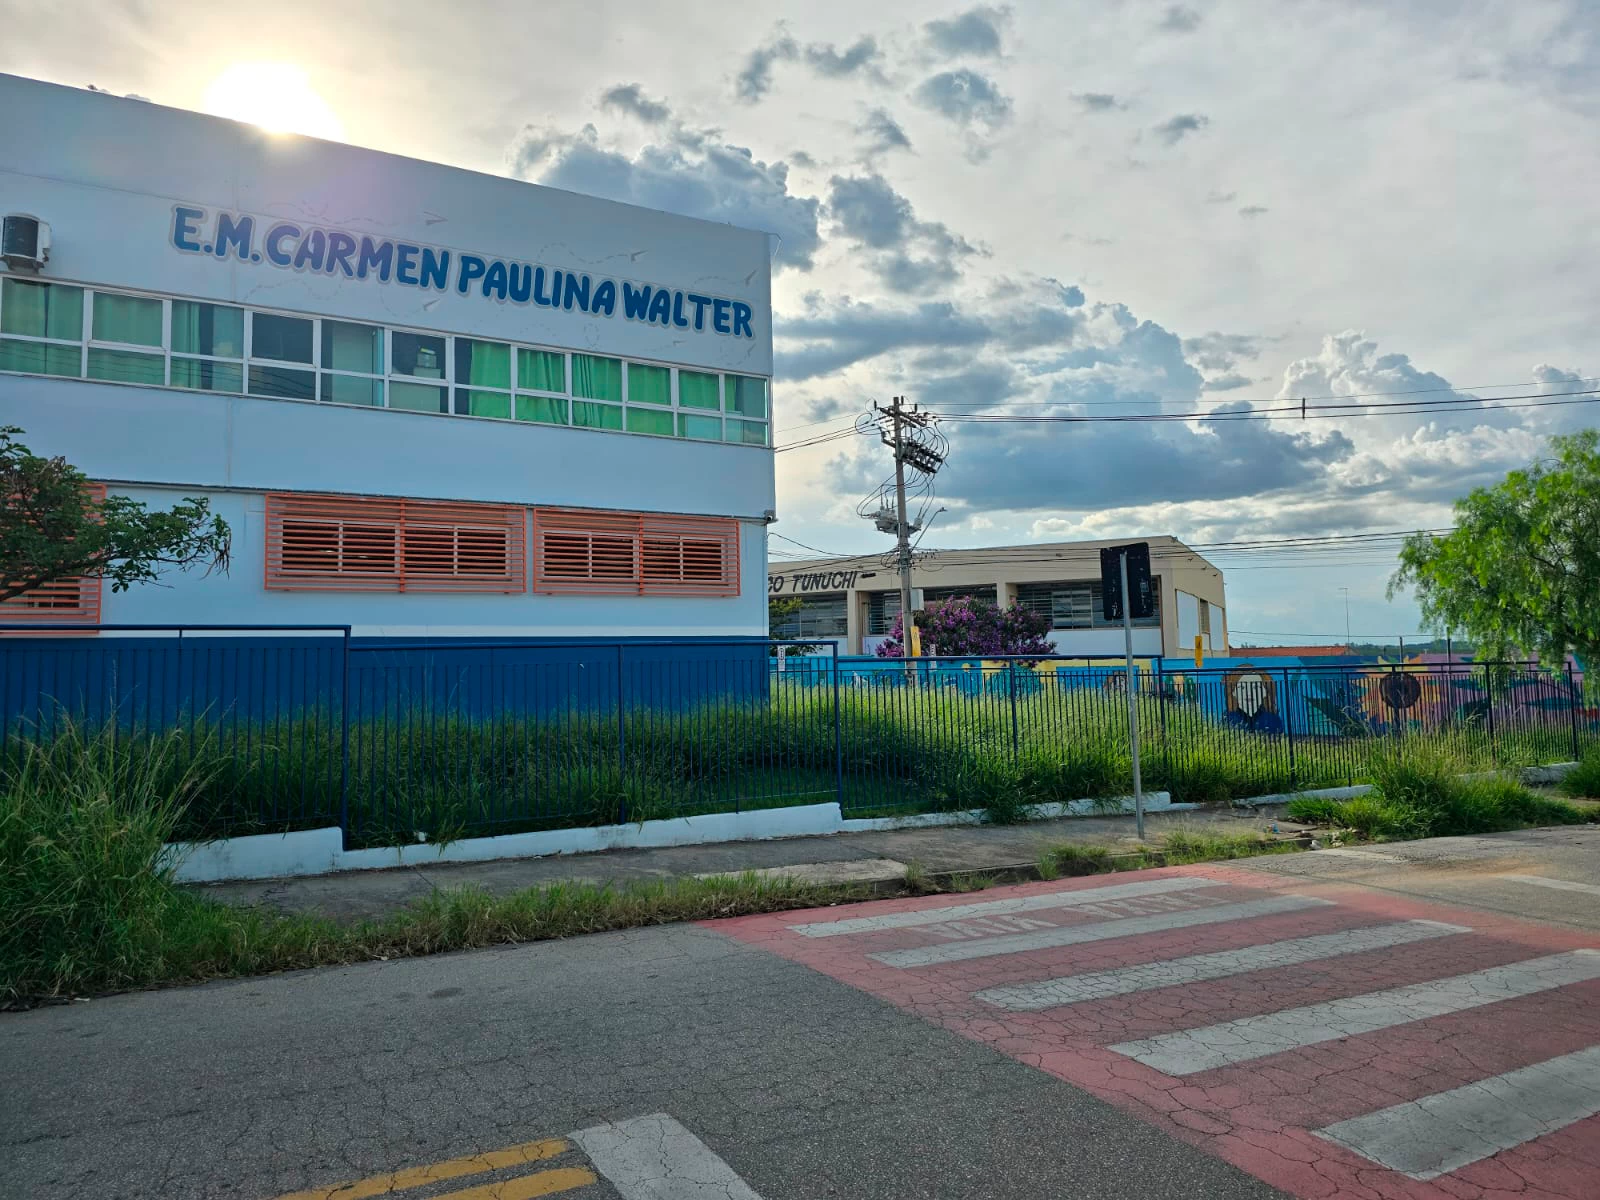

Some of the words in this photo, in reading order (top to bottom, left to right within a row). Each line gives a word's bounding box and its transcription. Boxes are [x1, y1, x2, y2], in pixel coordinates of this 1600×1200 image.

[172, 206, 262, 263] E.M.
[266, 224, 450, 290] CARMEN
[458, 255, 616, 316] PAULINA
[623, 282, 753, 338] WALTER
[793, 570, 858, 592] TUNUCHI
